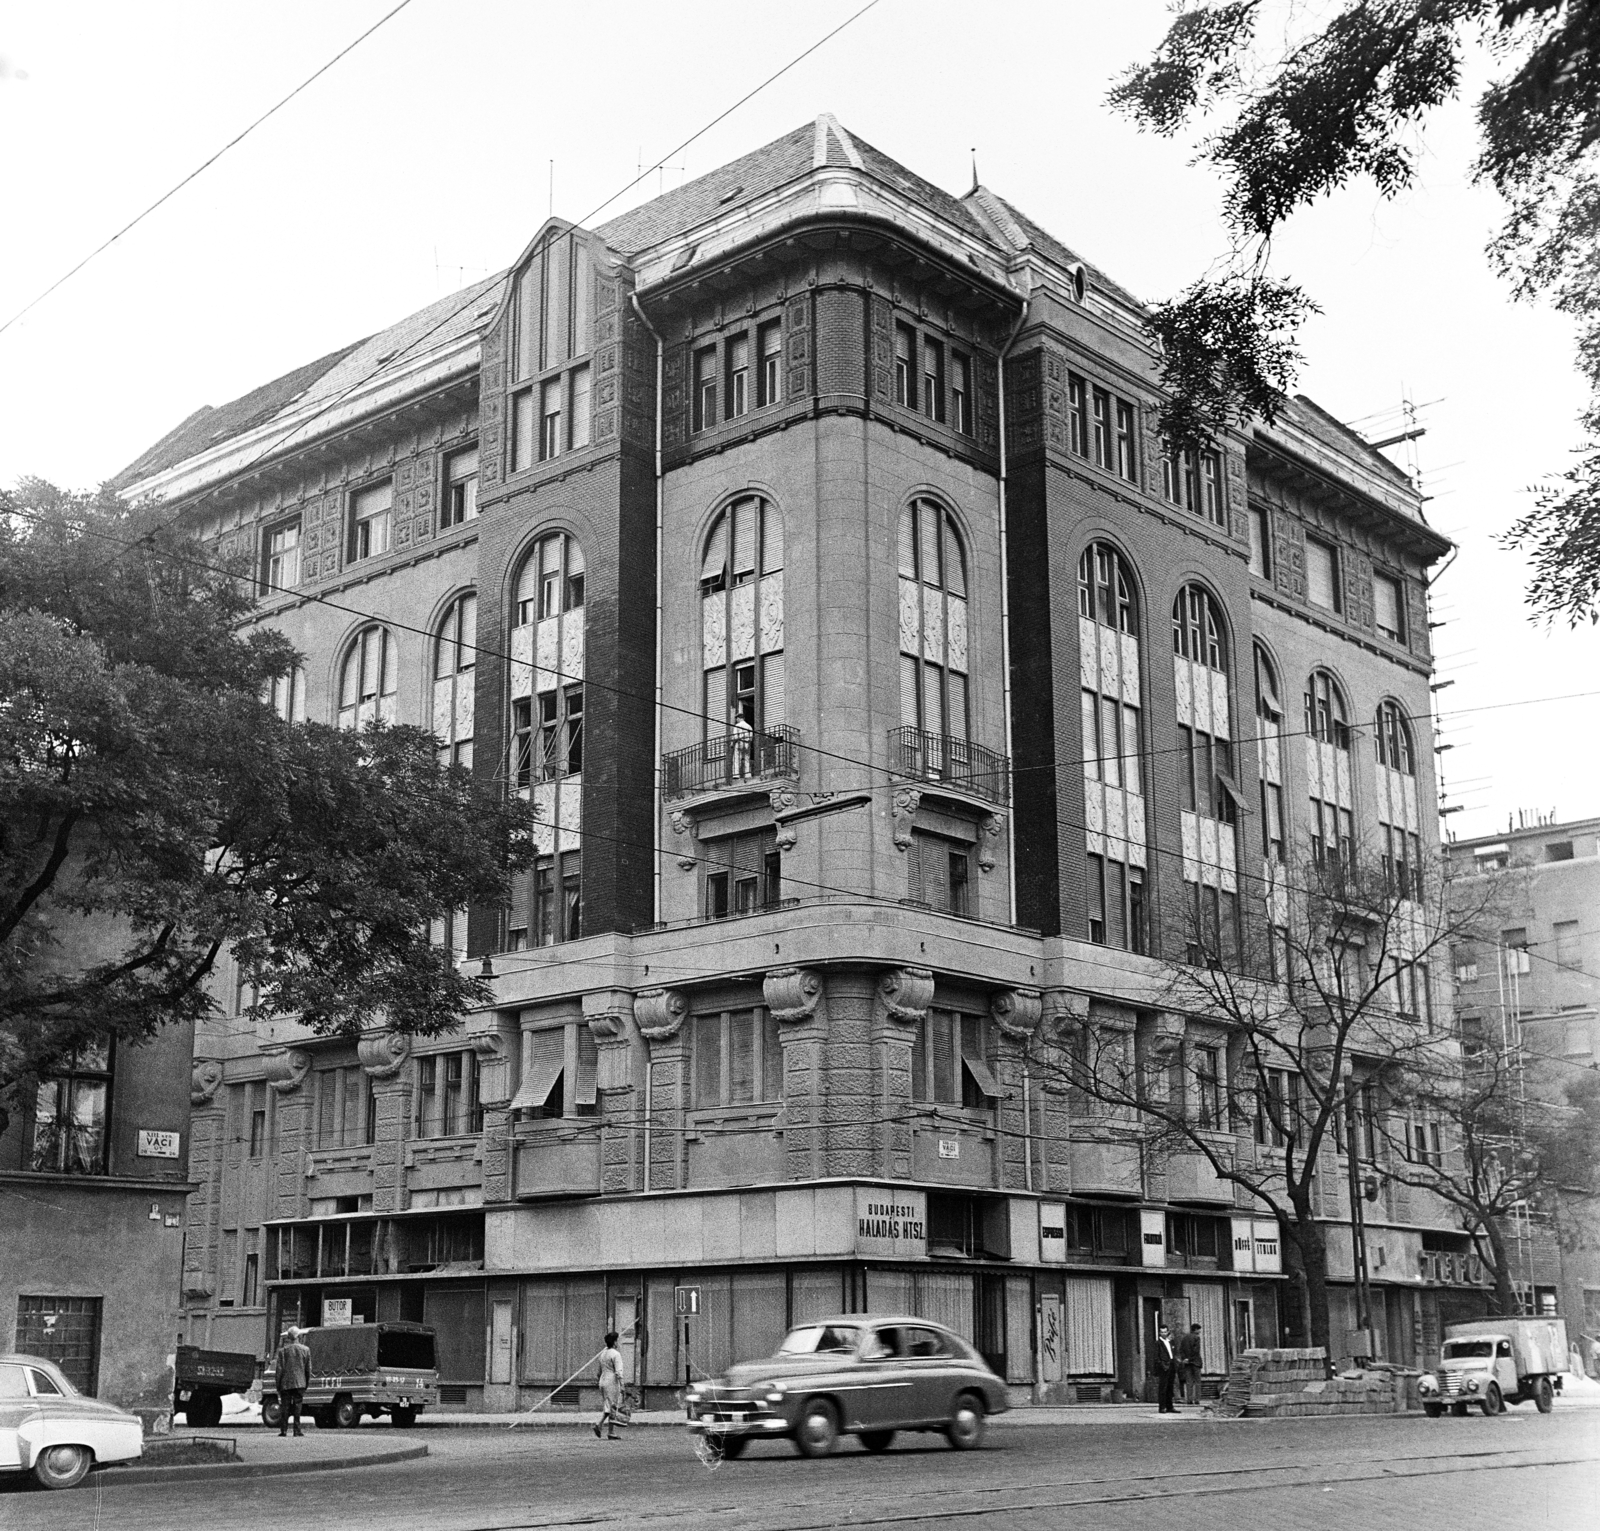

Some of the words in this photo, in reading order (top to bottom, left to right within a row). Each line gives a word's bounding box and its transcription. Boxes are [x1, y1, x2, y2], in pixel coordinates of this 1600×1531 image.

[868, 1203, 915, 1218] BUDAPESTI
[859, 1216, 900, 1239] HALADÁS
[902, 1221, 926, 1240] HTSZ.
[1421, 1250, 1484, 1284] TEFU
